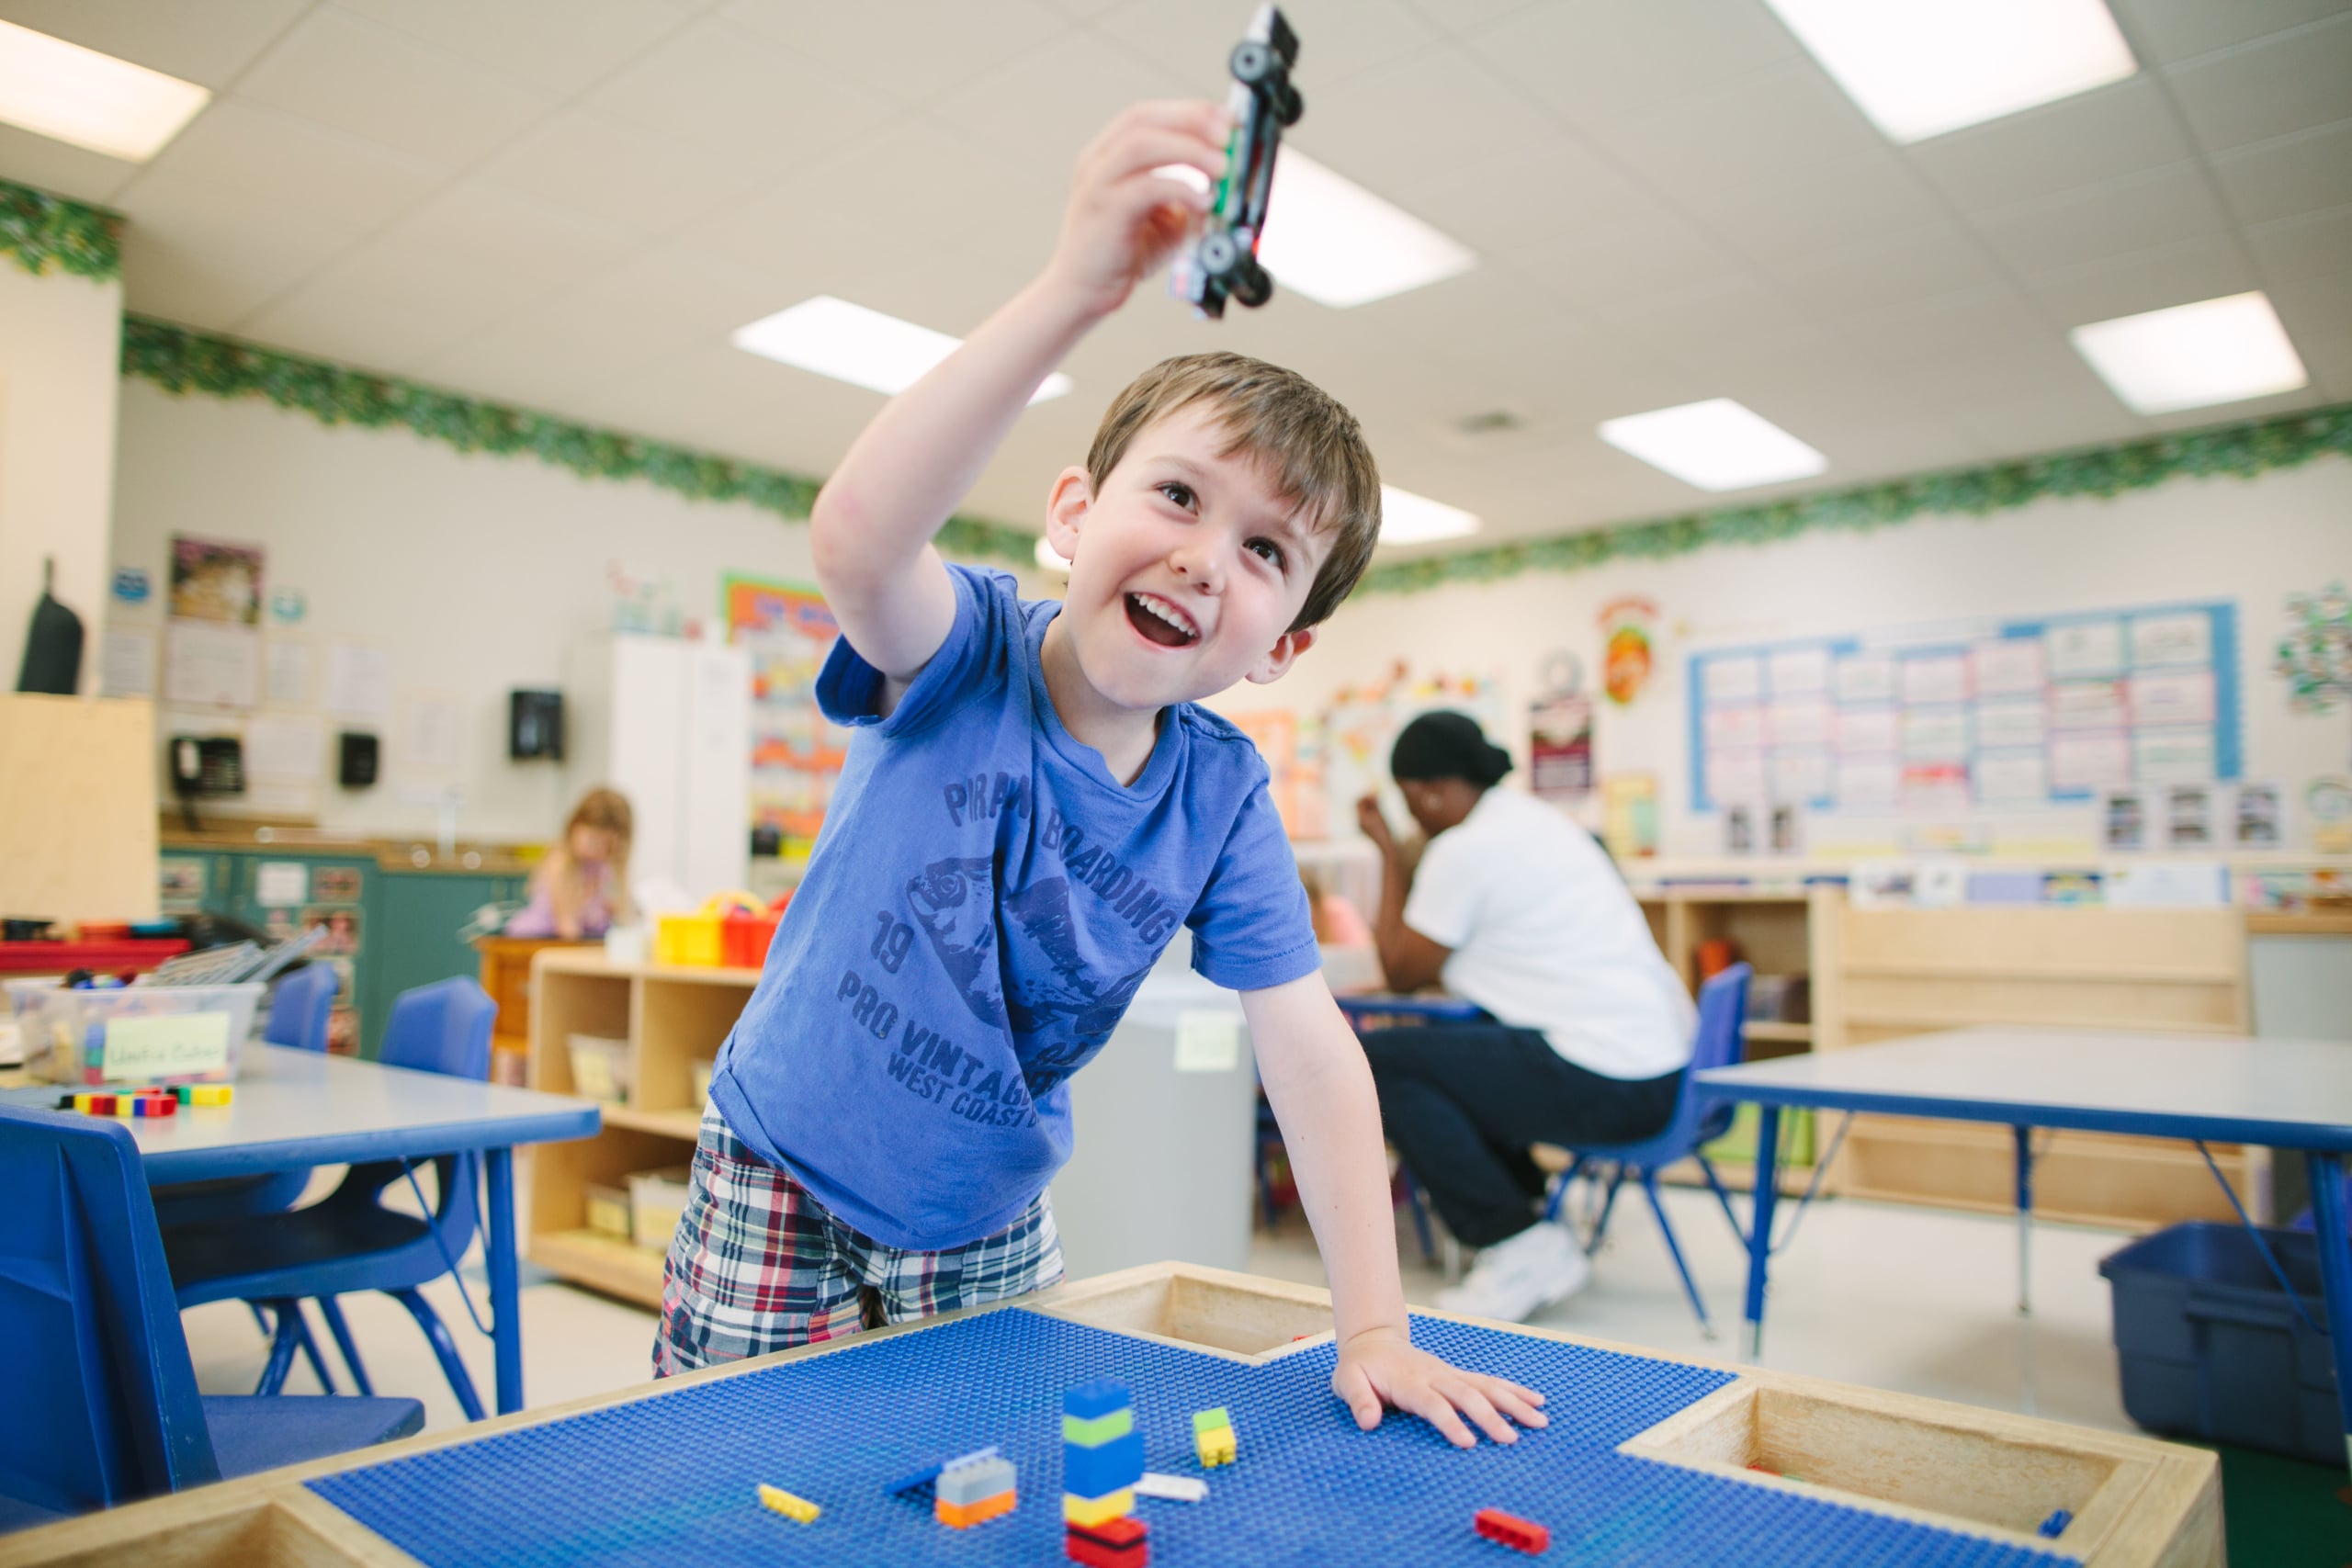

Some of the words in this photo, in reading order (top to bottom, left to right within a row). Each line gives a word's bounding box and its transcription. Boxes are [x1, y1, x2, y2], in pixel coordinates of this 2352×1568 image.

[1041, 807, 1178, 945] BOARDING
[871, 909, 915, 974] 19
[837, 969, 899, 1040] PRO
[888, 1052, 955, 1104] WEST
[951, 1091, 1029, 1128] COAST
